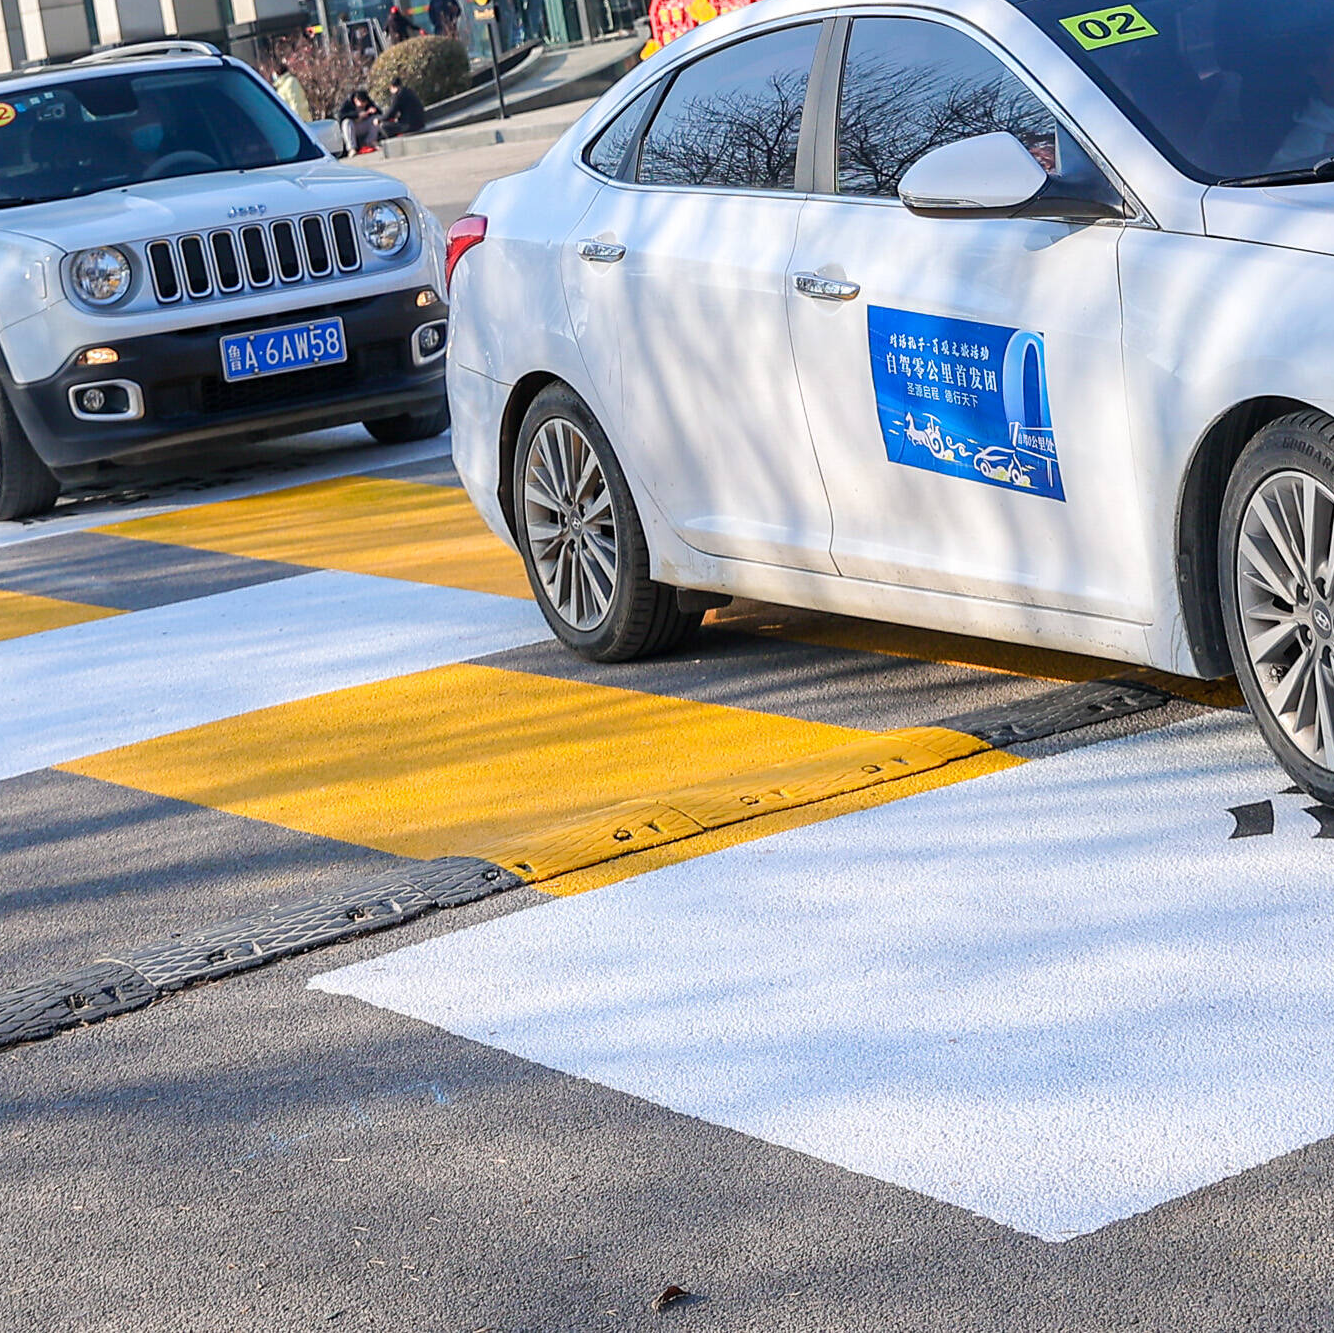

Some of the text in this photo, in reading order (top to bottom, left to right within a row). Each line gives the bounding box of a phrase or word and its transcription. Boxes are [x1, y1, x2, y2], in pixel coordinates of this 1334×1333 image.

[1077, 11, 1146, 40] 02
[228, 204, 267, 218] Jeep
[228, 327, 341, 372] 鲁A·6AW58
[886, 352, 998, 393] 自驾零公里首发团
[906, 381, 979, 408] 圣源启程 德行天下
